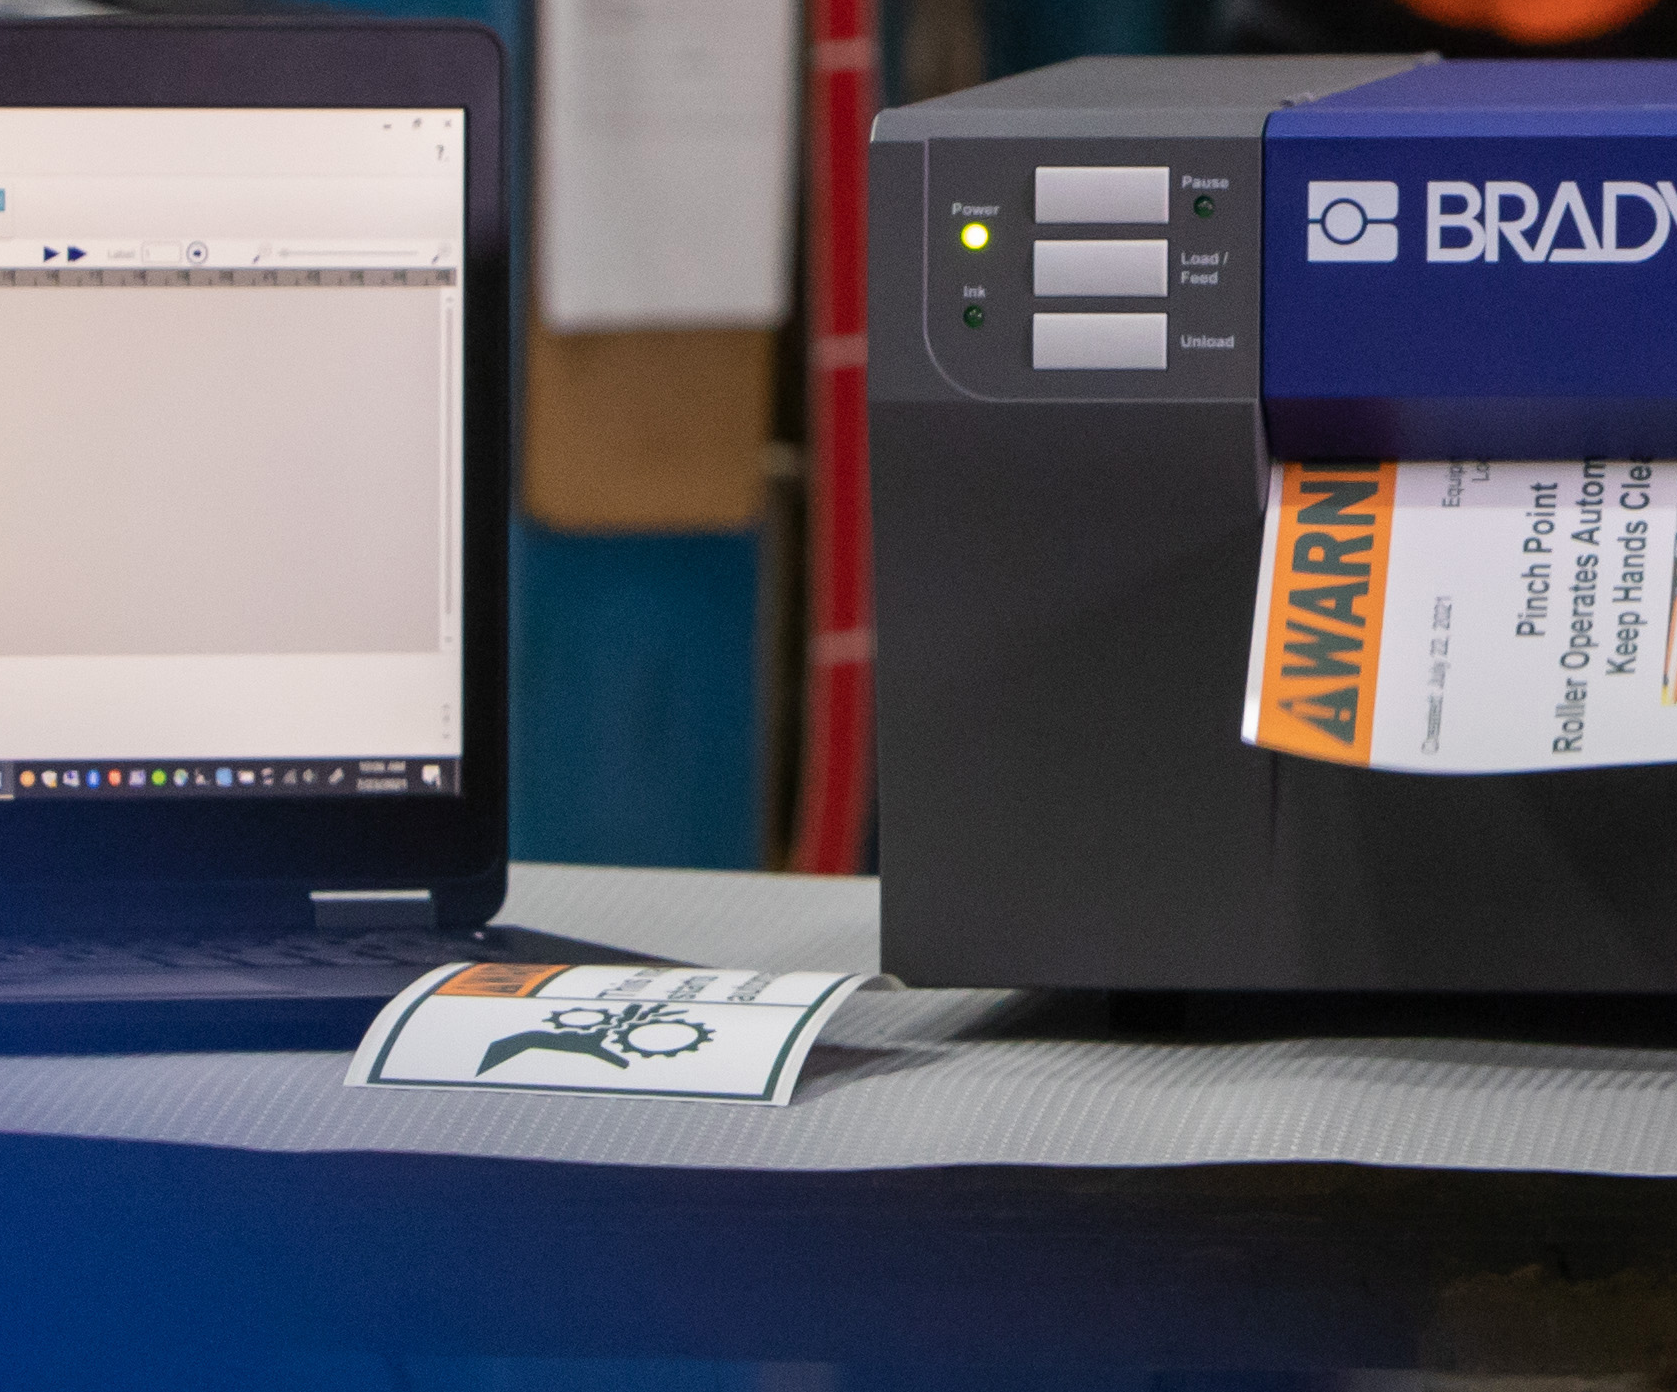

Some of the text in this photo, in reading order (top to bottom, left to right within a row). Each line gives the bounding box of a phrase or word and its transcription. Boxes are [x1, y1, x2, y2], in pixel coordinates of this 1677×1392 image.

[1181, 175, 1230, 190] Pause
[951, 201, 1000, 217] Power
[1180, 249, 1220, 265] Load
[1180, 270, 1219, 285] Feed
[963, 284, 986, 298] Ink
[1180, 333, 1235, 349] Unload
[1515, 481, 1559, 637] Pinch Point
[1611, 519, 1649, 603] Hands
[1559, 552, 1600, 670] Operates
[1605, 609, 1648, 676] Keep
[1551, 677, 1589, 755] Roller
